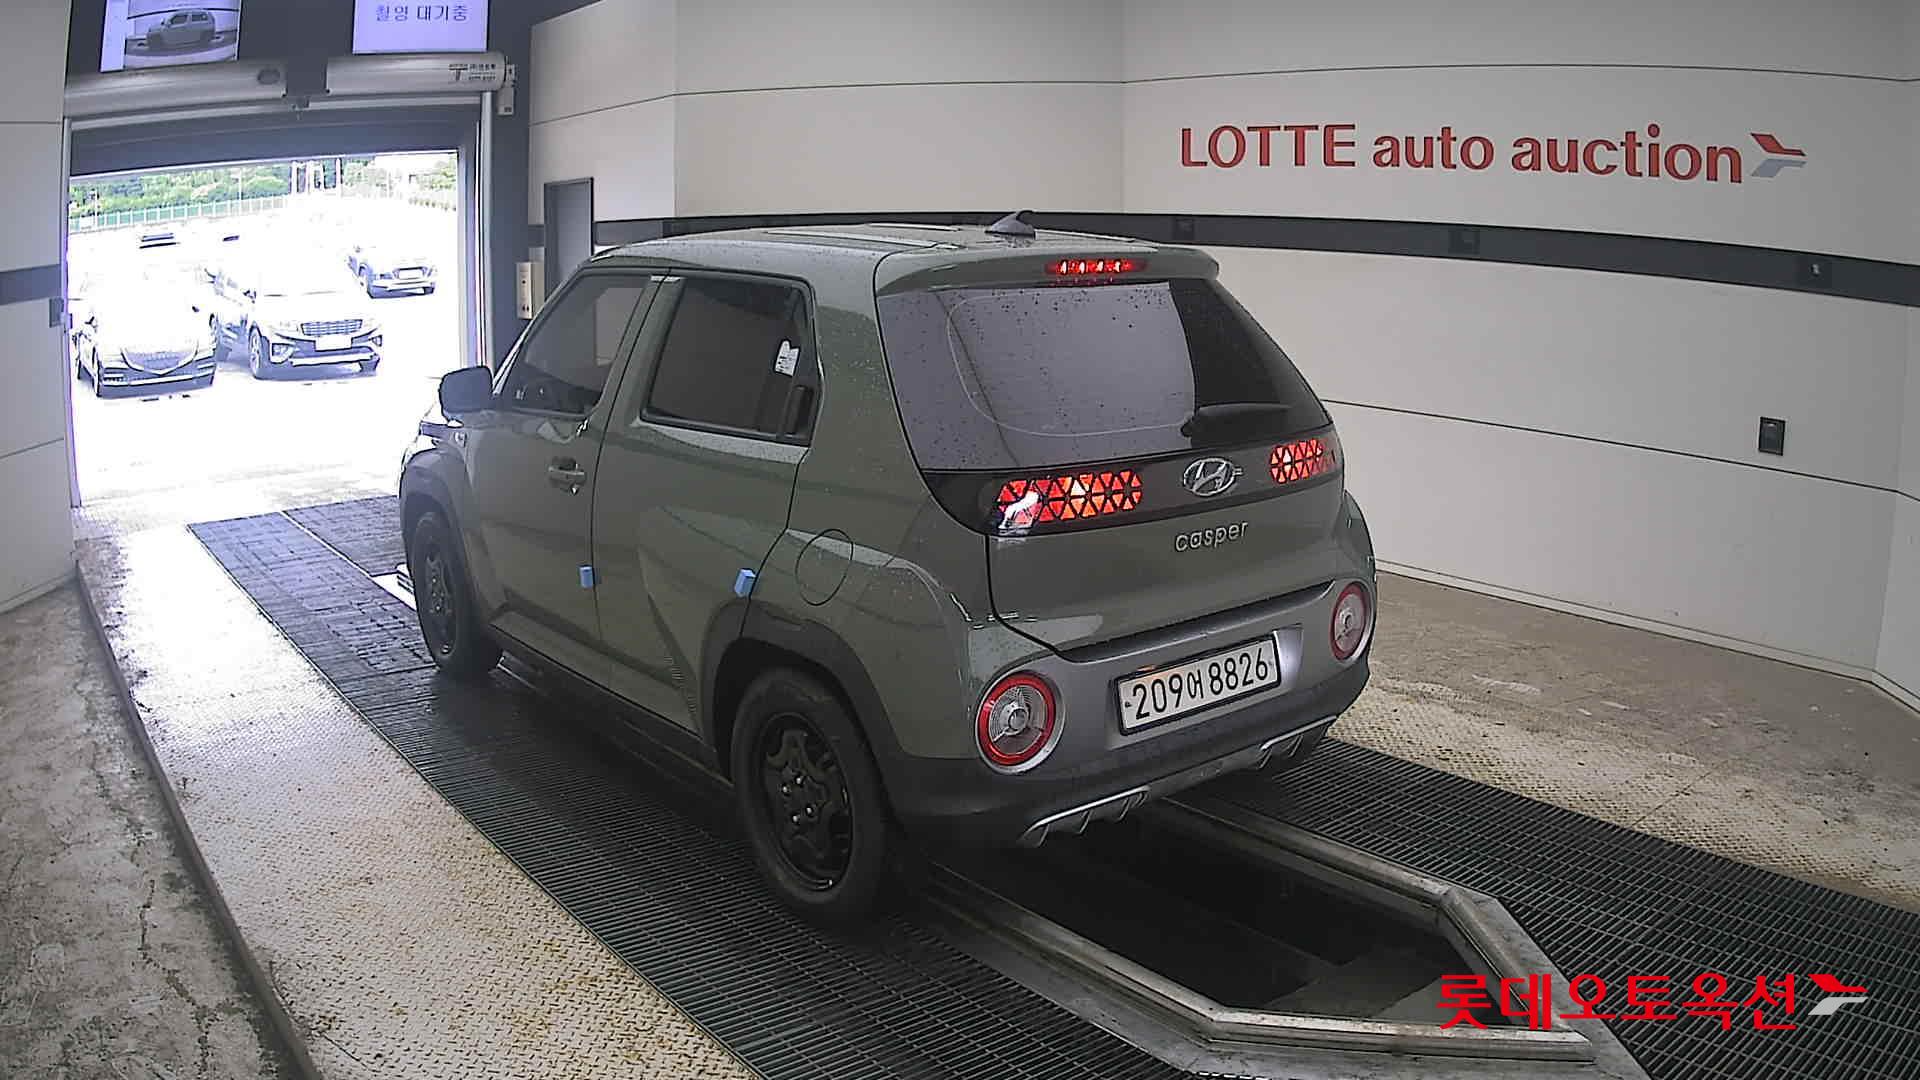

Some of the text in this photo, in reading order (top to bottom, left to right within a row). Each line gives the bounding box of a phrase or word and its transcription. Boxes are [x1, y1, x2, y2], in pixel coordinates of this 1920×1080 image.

[1181, 123, 1742, 183] LOTTE auto auction
[1175, 521, 1249, 552] casper
